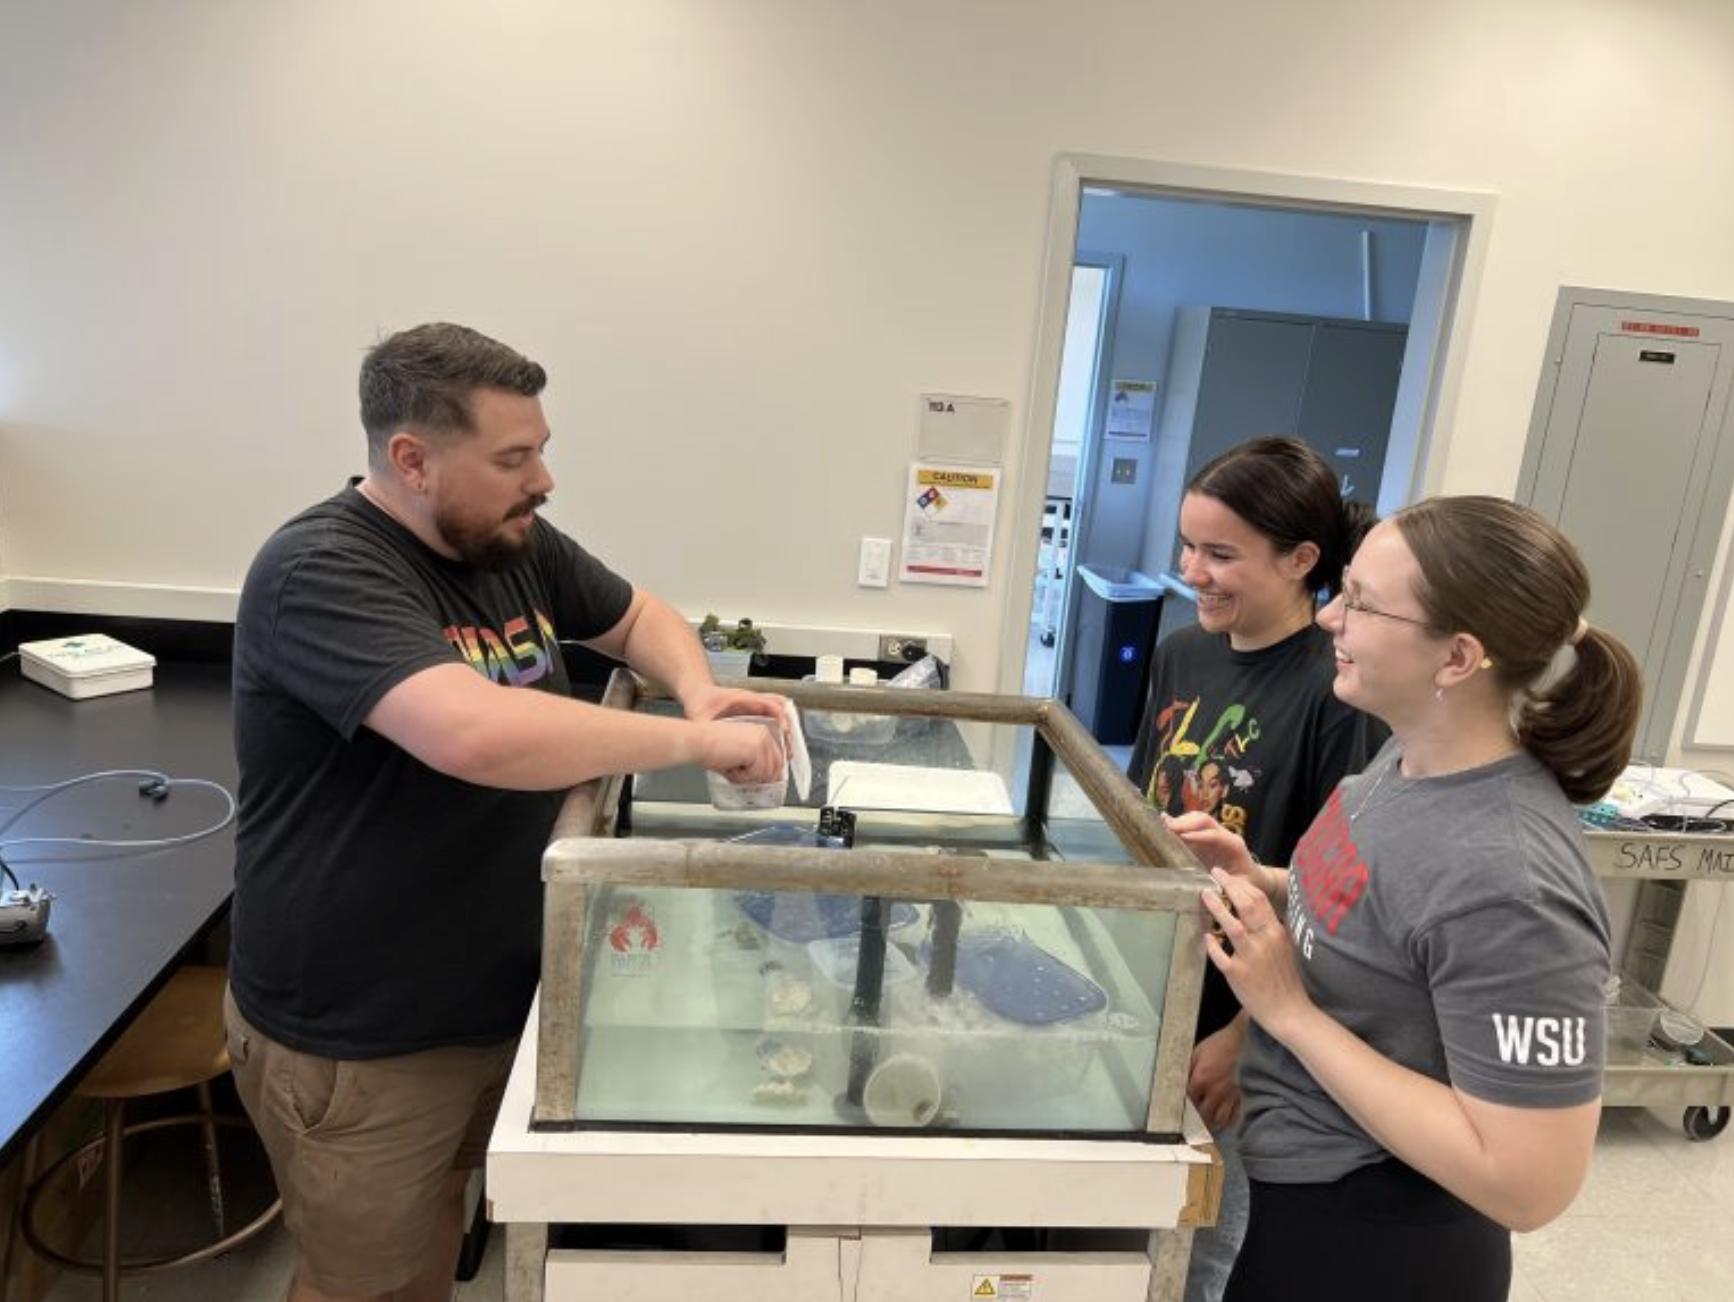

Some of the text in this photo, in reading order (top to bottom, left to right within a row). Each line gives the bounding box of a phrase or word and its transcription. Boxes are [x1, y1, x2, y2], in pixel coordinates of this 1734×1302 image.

[932, 472, 978, 484] CAUTION
[1613, 842, 1686, 871] SAFS
[1491, 1012, 1585, 1067] WSU
